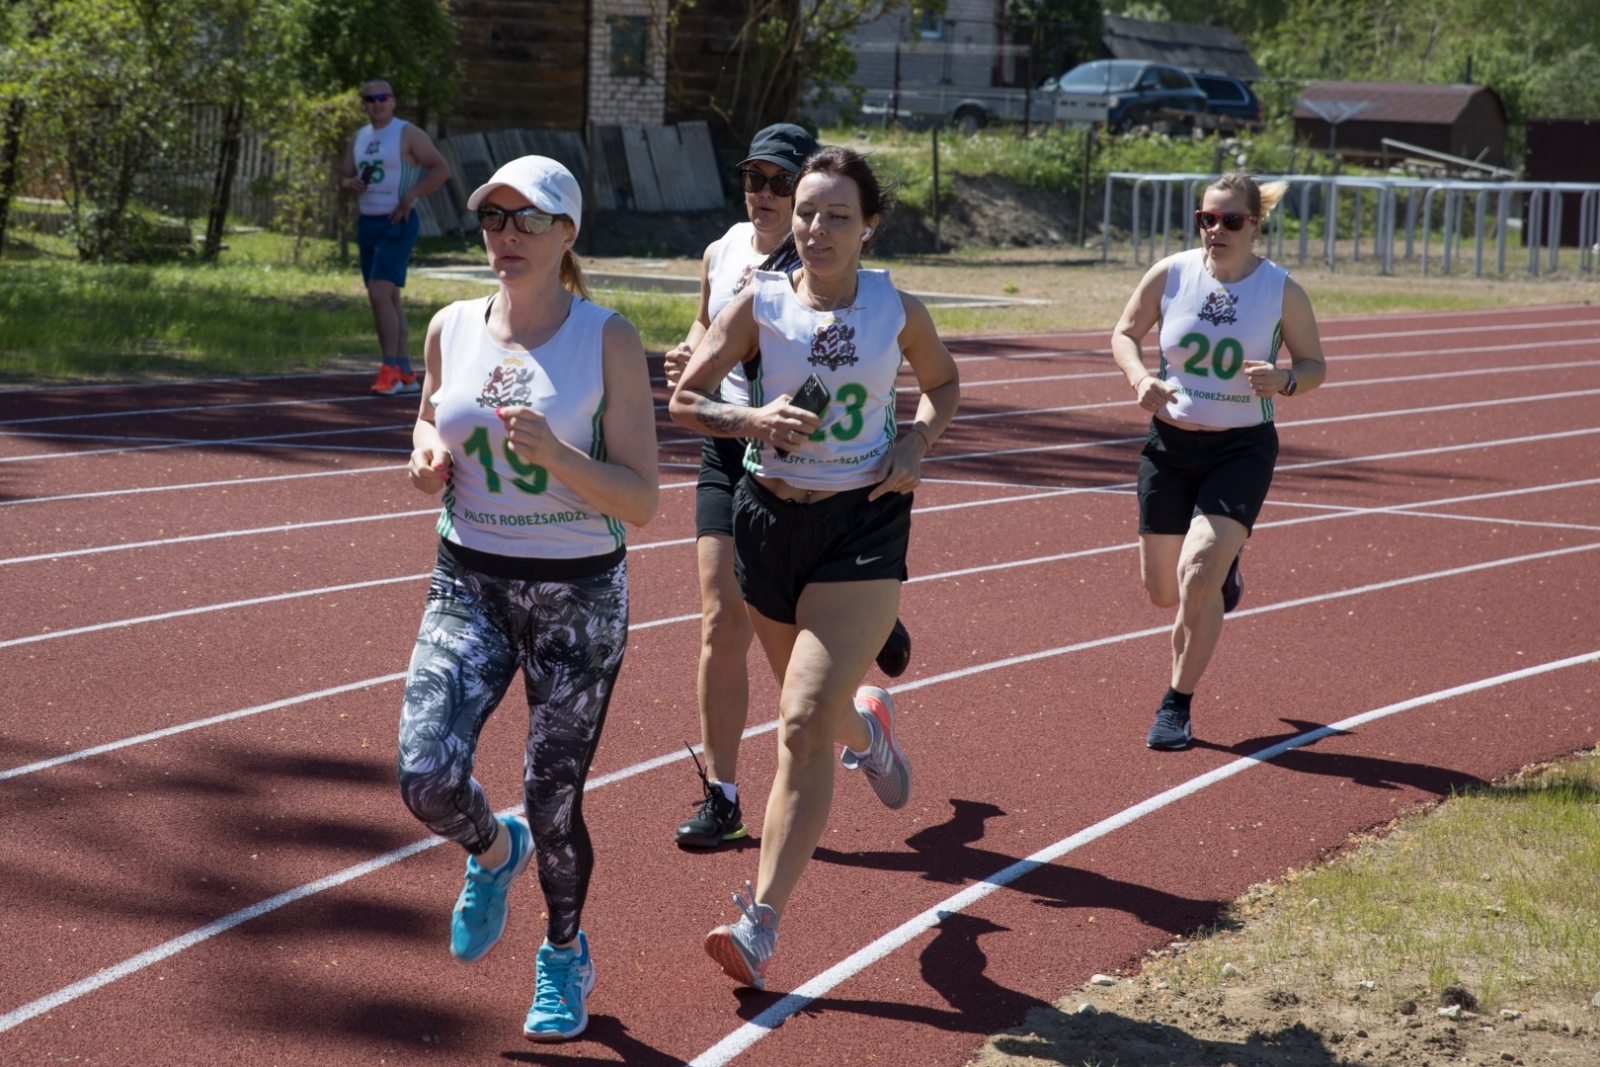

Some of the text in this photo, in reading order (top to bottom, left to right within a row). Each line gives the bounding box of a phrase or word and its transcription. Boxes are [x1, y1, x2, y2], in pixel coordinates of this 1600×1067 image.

[1178, 331, 1245, 380] 20
[1171, 384, 1251, 403] LSTS ROBEŽSARDZE
[461, 425, 549, 495] 19
[464, 507, 590, 526] VALSTS ROBEŽSARDZE
